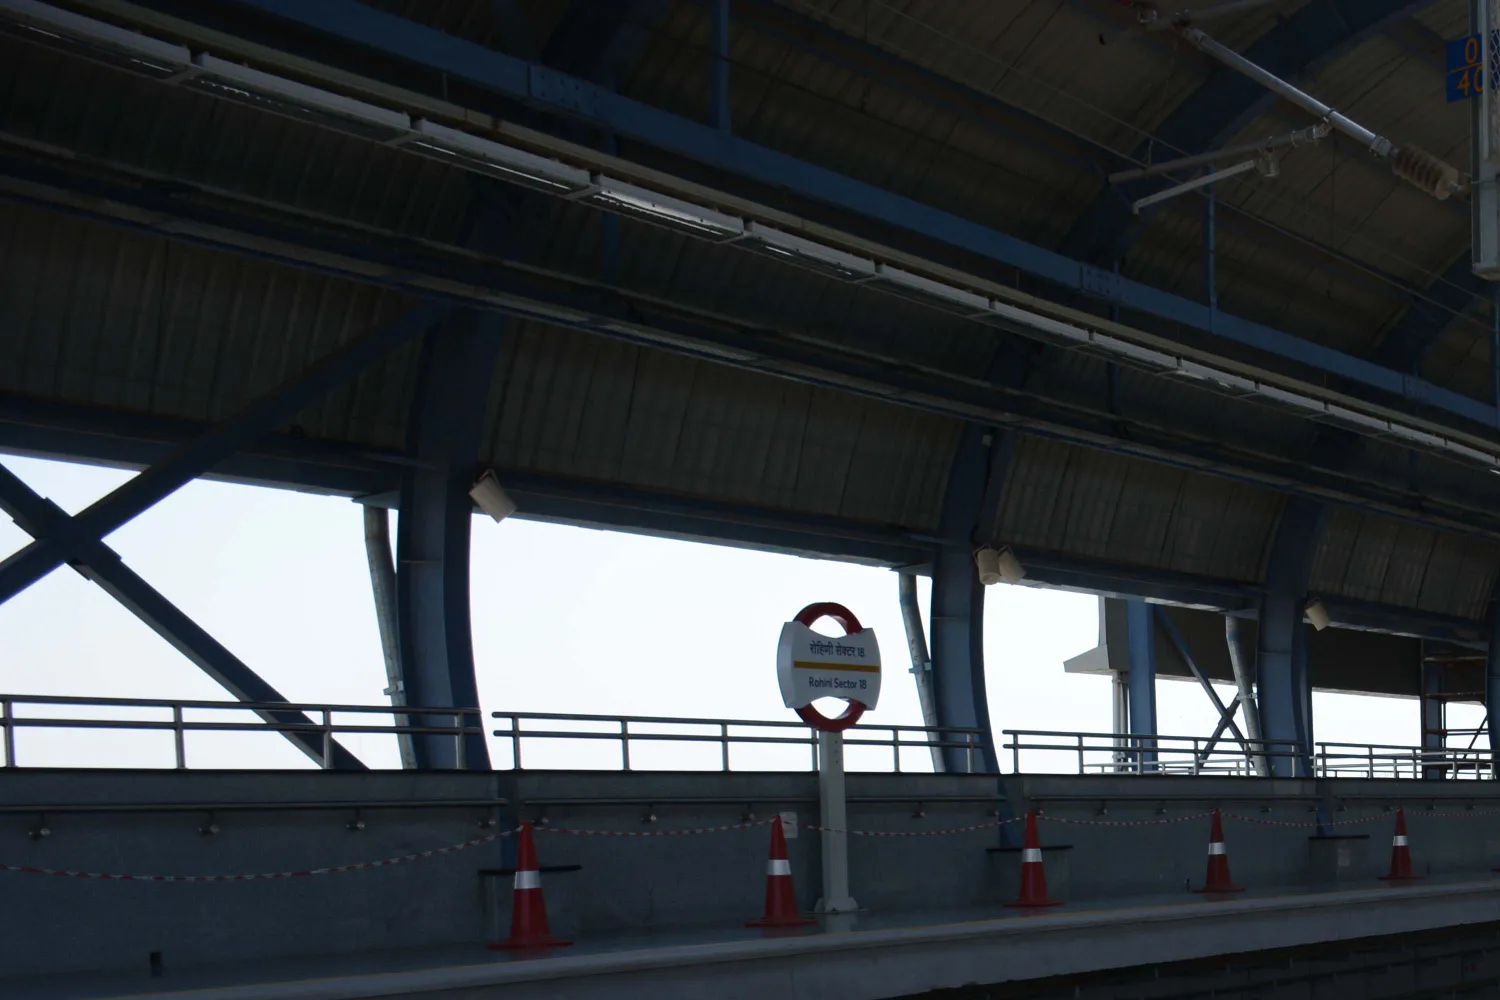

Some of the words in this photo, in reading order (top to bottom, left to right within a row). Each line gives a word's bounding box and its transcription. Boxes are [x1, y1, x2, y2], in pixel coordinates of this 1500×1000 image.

[809, 640, 834, 656] रोहिणी
[835, 641, 856, 657] सेक्टर
[808, 676, 833, 688] Rohini
[834, 677, 857, 689] Sector
[858, 679, 867, 690] 18
